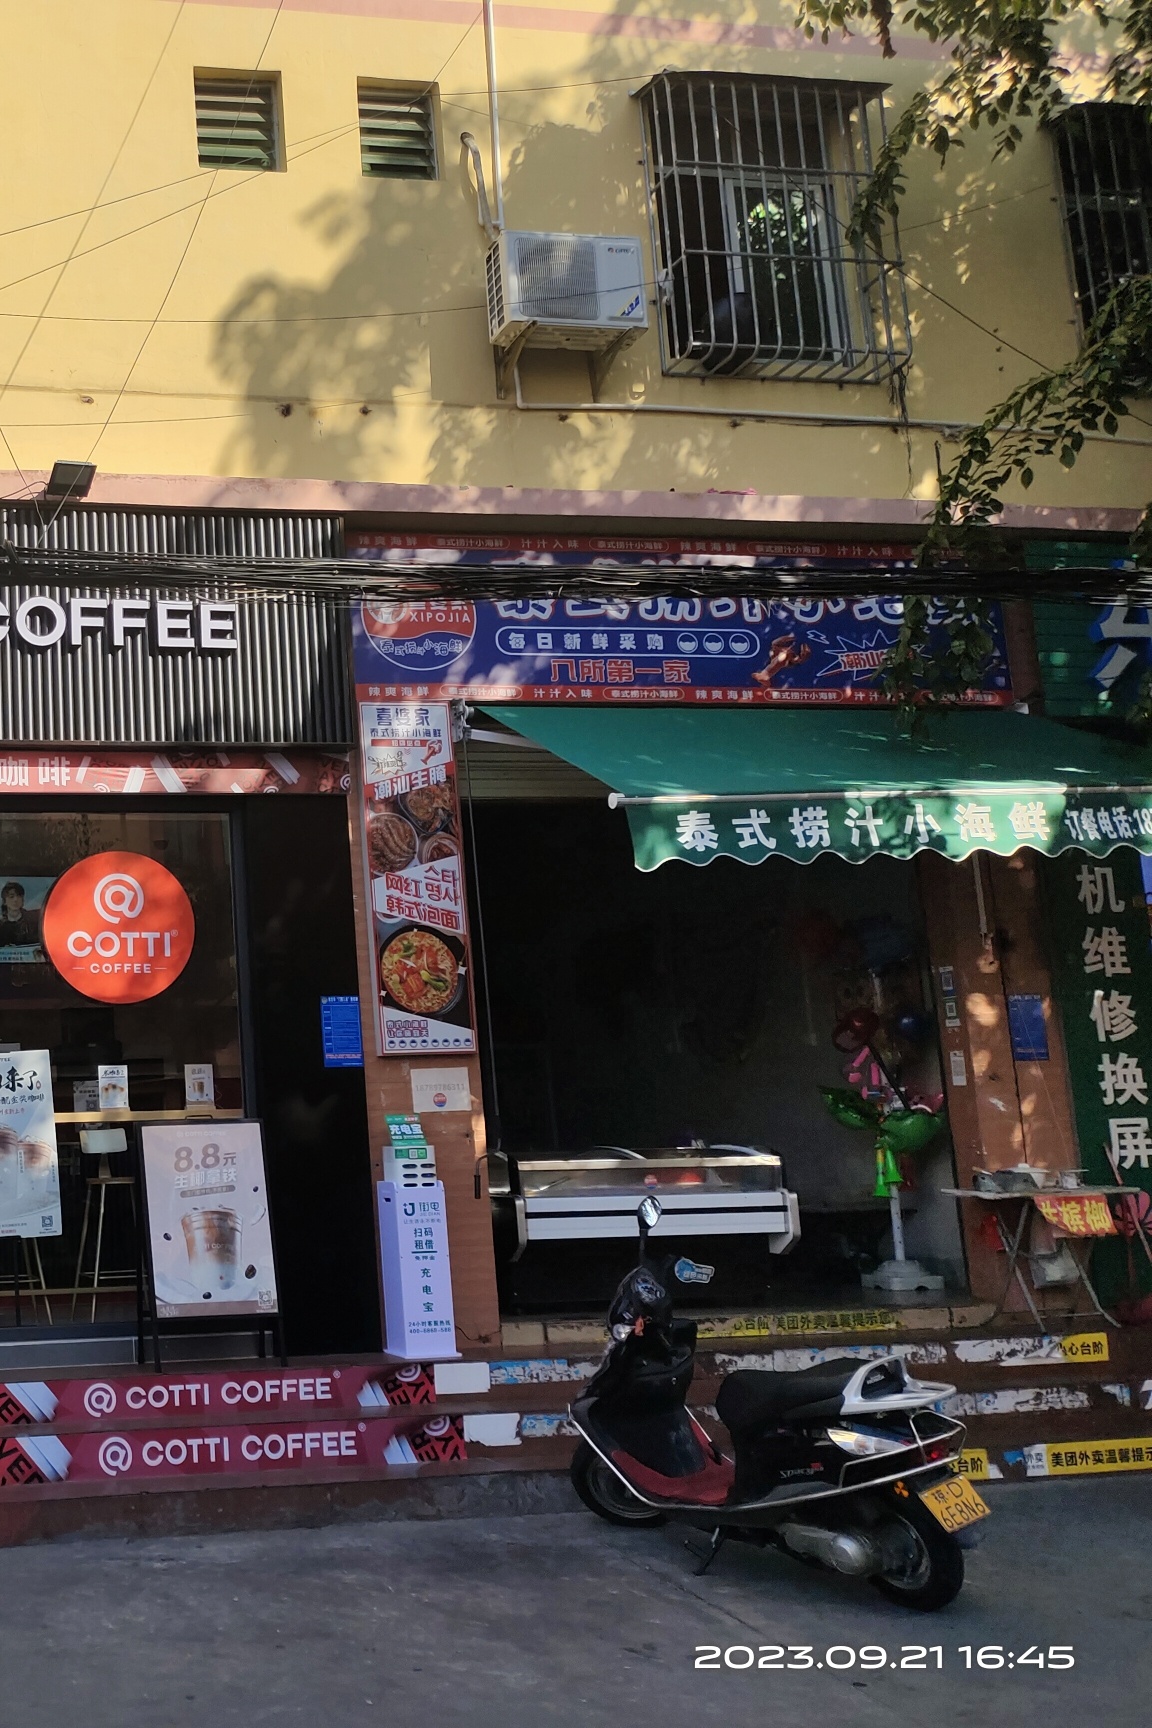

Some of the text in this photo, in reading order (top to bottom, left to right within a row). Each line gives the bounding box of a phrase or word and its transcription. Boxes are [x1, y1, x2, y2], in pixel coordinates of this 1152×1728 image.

[521, 538, 579, 549] 汁汁入味
[409, 611, 471, 623] XIPOJIA
[508, 632, 664, 651] 每日新鲜采购
[551, 658, 691, 684] 八所第一家
[369, 686, 429, 697] 辣爽海鲜
[533, 688, 593, 699] 汁汁入味
[376, 707, 430, 727] 喜婆家
[374, 763, 447, 801] 潮汕生腌
[675, 801, 1050, 852] 泰式捞汁小海鲜
[385, 872, 422, 899] 网红
[386, 894, 460, 931] 韩式泡面
[67, 930, 172, 958] COTTI
[90, 963, 152, 975] COFFEE
[389, 1123, 424, 1135] 充电宝
[174, 1168, 237, 1189] 生椰拿铁
[414, 1227, 433, 1238] 扫码
[414, 1239, 434, 1250] 租借
[421, 1268, 434, 1313] 充电宝
[126, 1382, 210, 1410] COTTI
[221, 1376, 332, 1405] COFFEE
[142, 1438, 229, 1467] COTTI
[241, 1430, 357, 1462] COFFEE
[940, 1499, 986, 1529] 6E8N6
